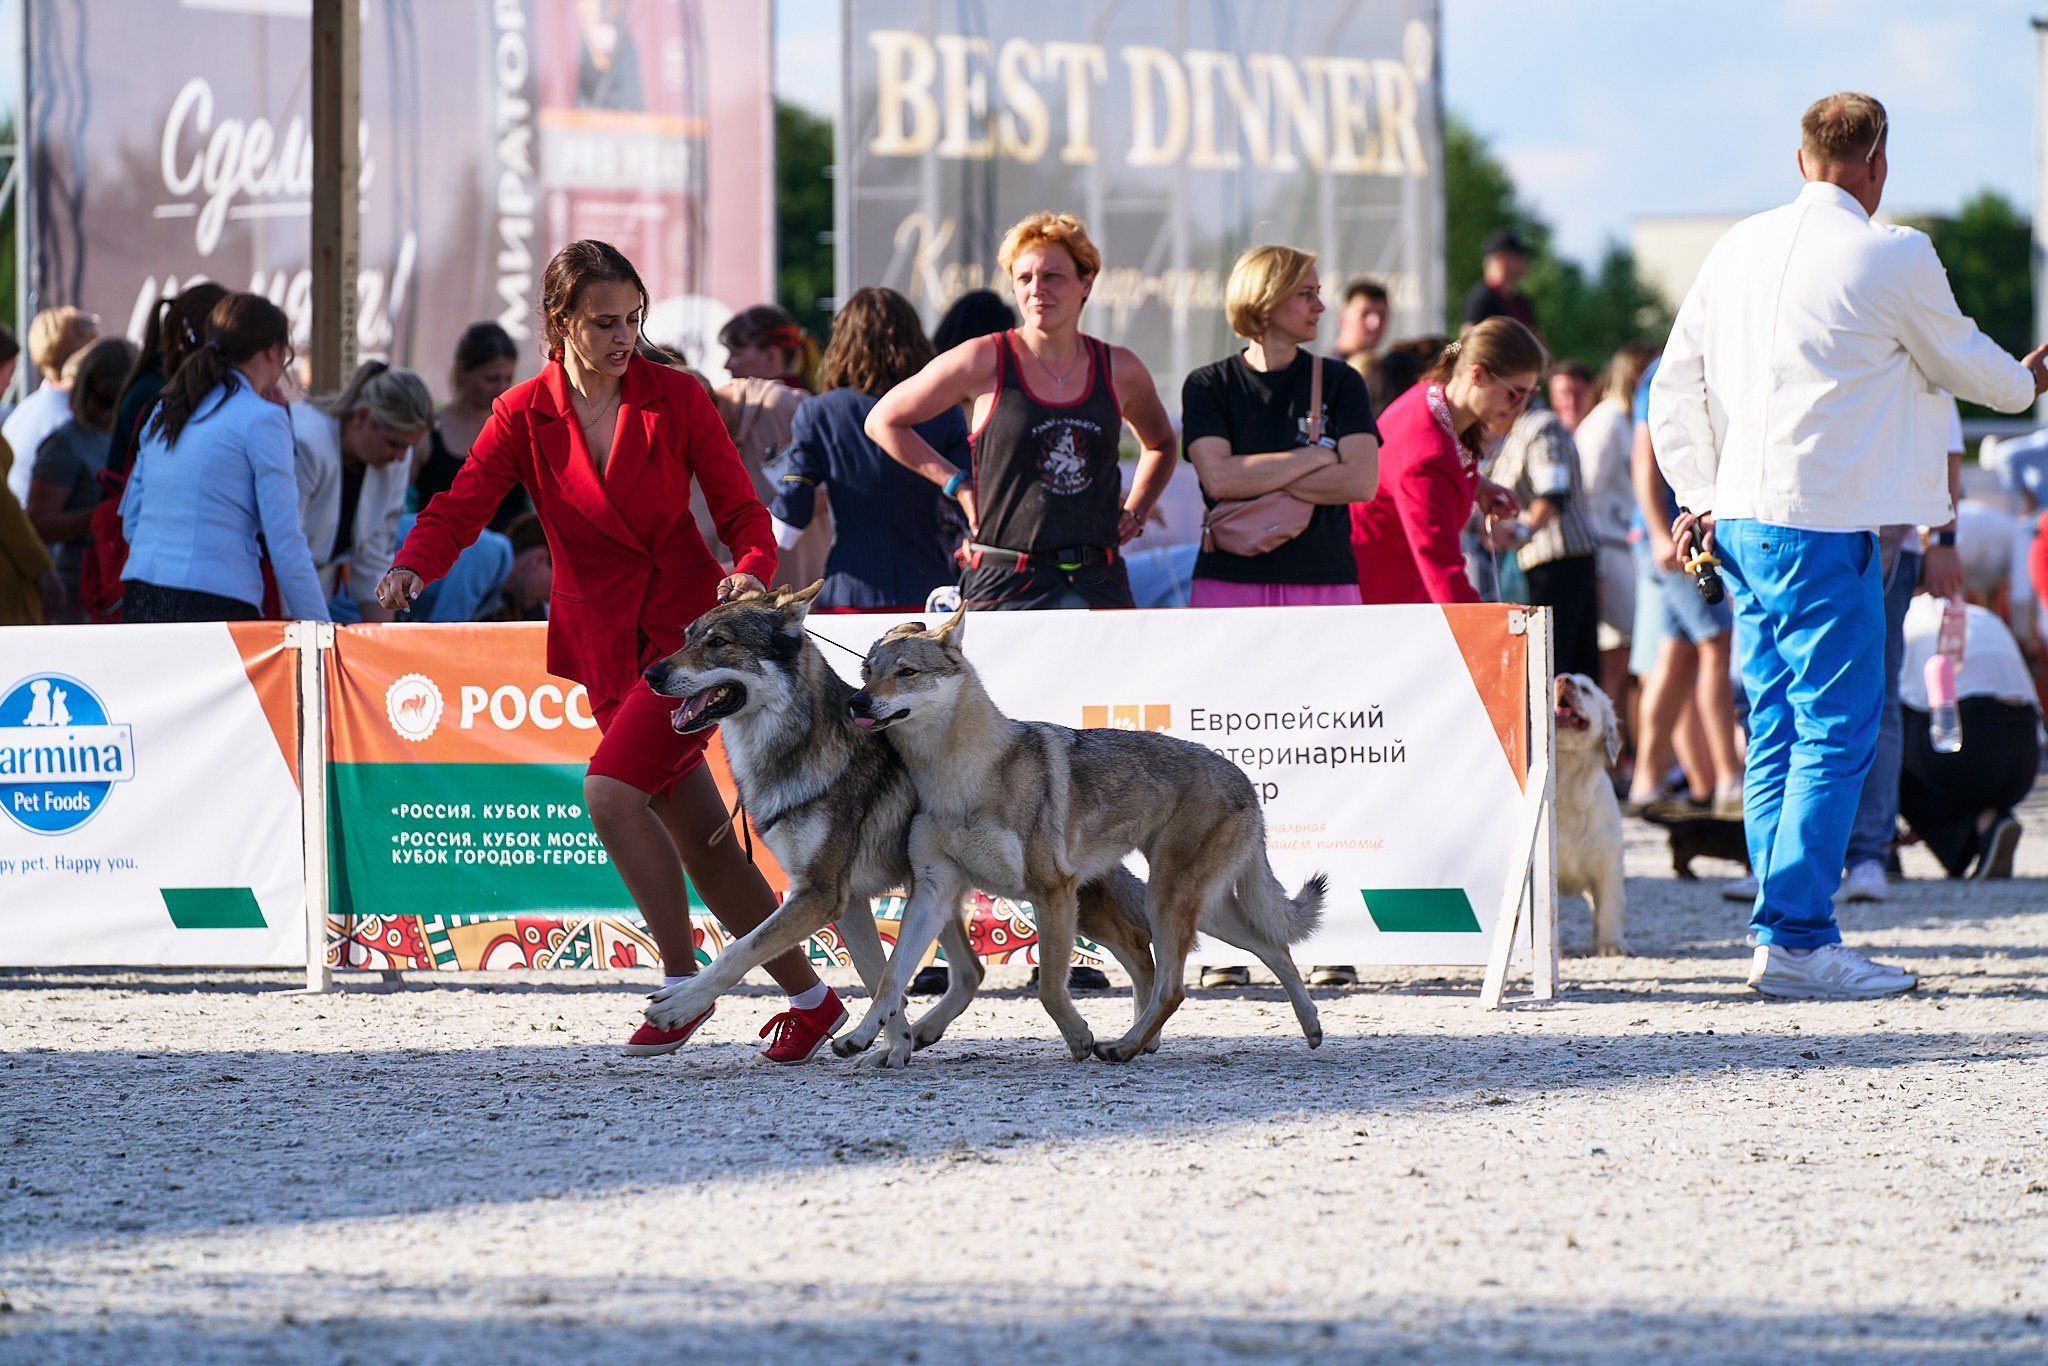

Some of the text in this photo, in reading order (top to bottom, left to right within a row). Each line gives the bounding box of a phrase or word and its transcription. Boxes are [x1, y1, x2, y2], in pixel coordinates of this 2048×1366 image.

[867, 29, 1429, 178] BEST DINNER
[160, 76, 376, 257] Сдел
[459, 684, 598, 731] РОСС
[1190, 704, 1384, 736] Европейский
[0, 734, 122, 775] armina
[1214, 739, 1406, 770] теринарный
[14, 790, 91, 812] Pet Foods
[391, 803, 582, 820] «РОССИЯ. КУБОК РКФ
[391, 831, 604, 848] «РОССИЯ. КУБОК МОСК
[22, 856, 49, 874] pet.
[55, 854, 101, 874] Happy
[107, 856, 139, 873] you.
[391, 849, 608, 867] КУБОК ГОРОДОВ-ГЕРОЕВ
